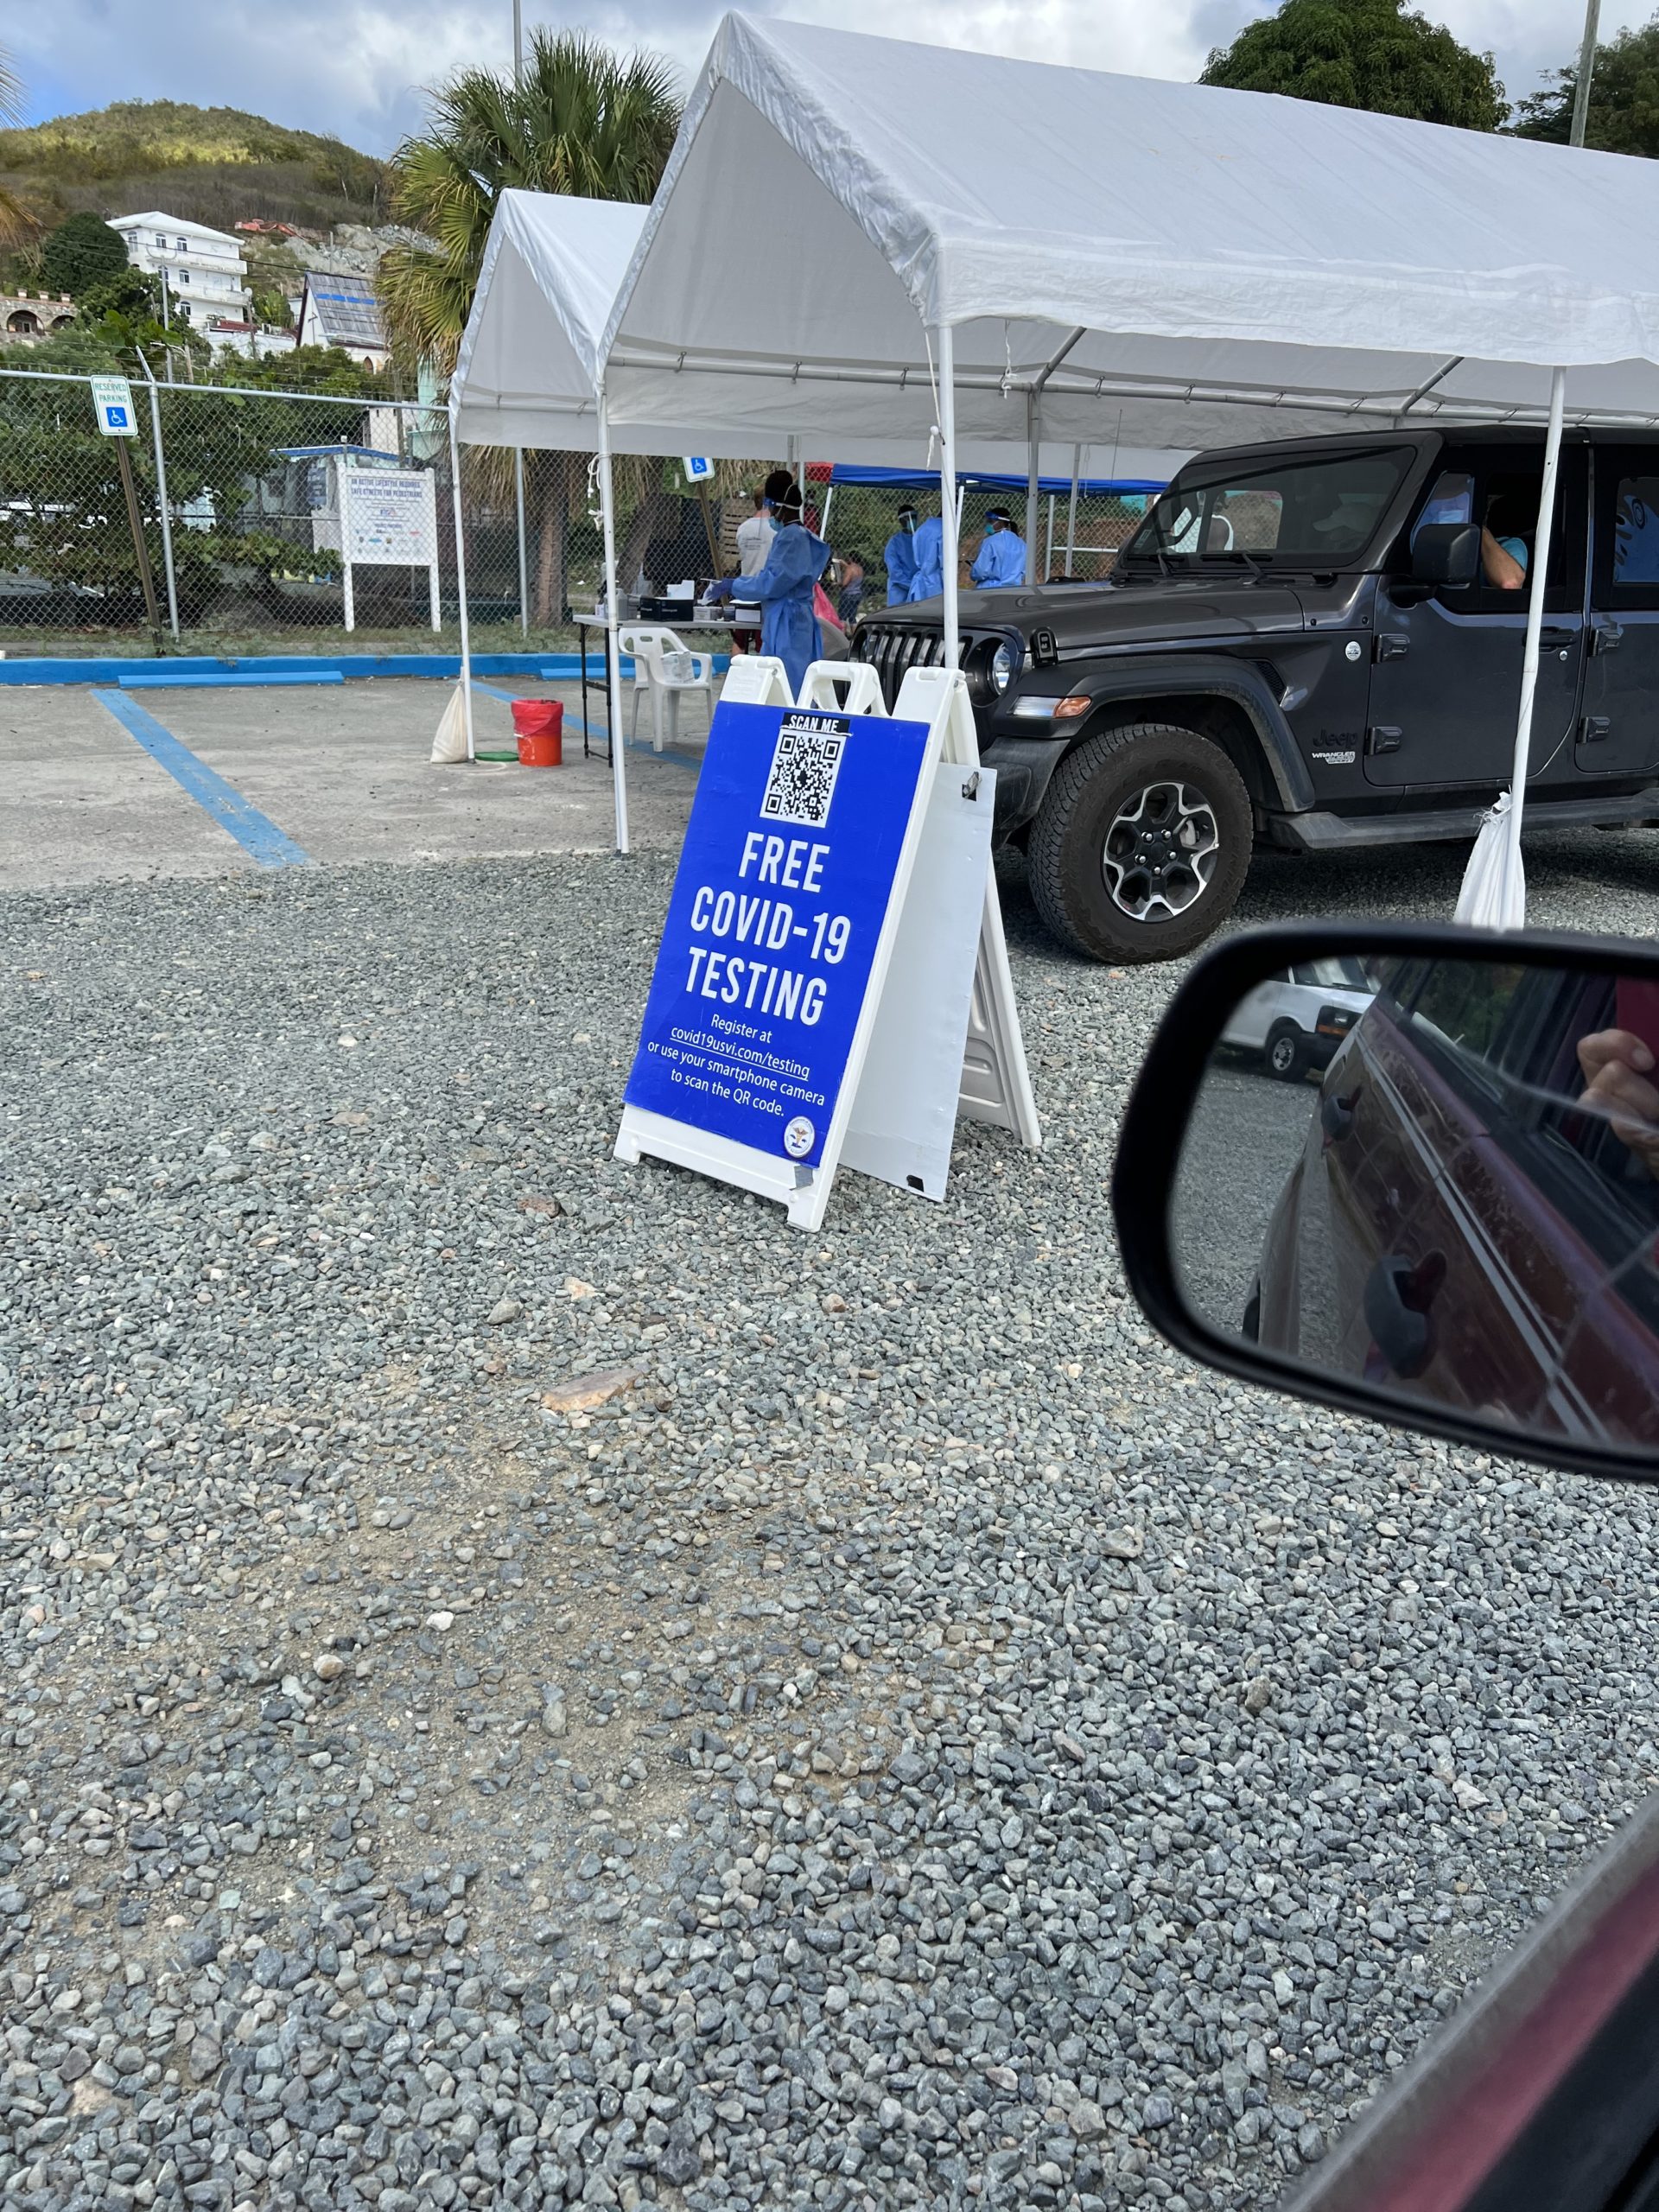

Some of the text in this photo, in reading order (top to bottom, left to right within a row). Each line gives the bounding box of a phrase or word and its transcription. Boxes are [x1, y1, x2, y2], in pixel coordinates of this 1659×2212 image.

[95, 383, 126, 391] RESERVED
[788, 715, 840, 733] SCAN ME
[1313, 728, 1357, 749] Jeep
[738, 831, 830, 893] FREE
[690, 886, 851, 964] COVID-19
[685, 946, 827, 1027] TESTING
[671, 1027, 810, 1080] covid19usvi.com/testing
[711, 1014, 772, 1043] Register at
[648, 1042, 825, 1106] or use your smartphone camera
[671, 1068, 784, 1116] to scan the QR code.
